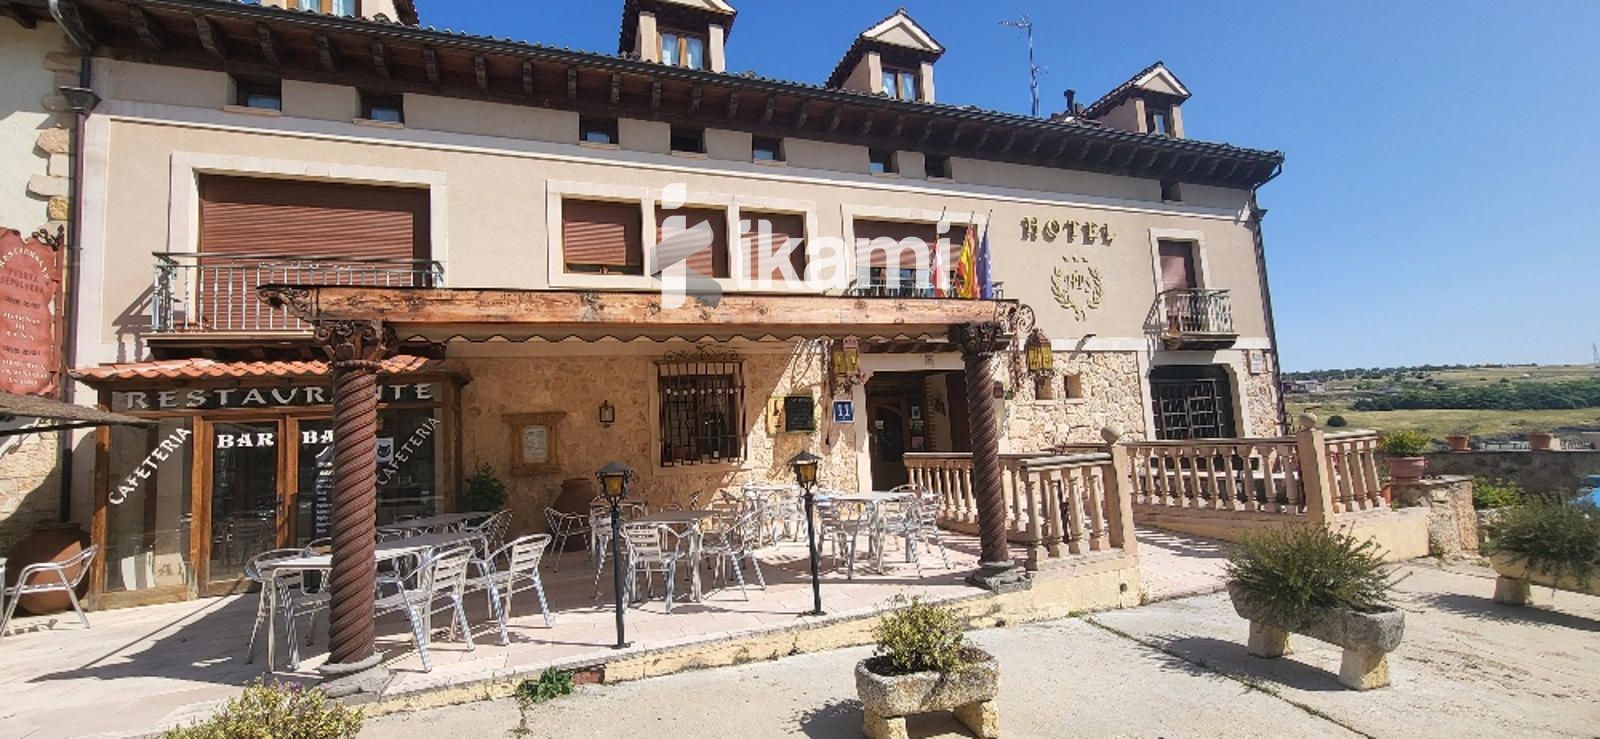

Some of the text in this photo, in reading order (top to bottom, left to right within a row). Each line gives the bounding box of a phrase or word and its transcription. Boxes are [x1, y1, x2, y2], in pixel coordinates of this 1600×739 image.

[1019, 215, 1116, 247] HOTEL
[125, 383, 433, 409] RESTAURTE
[837, 403, 851, 417] 11
[216, 432, 275, 449] BAR
[302, 429, 334, 444] BA
[376, 415, 441, 486] CAFETERIA
[108, 426, 193, 506] CAFETERIA
